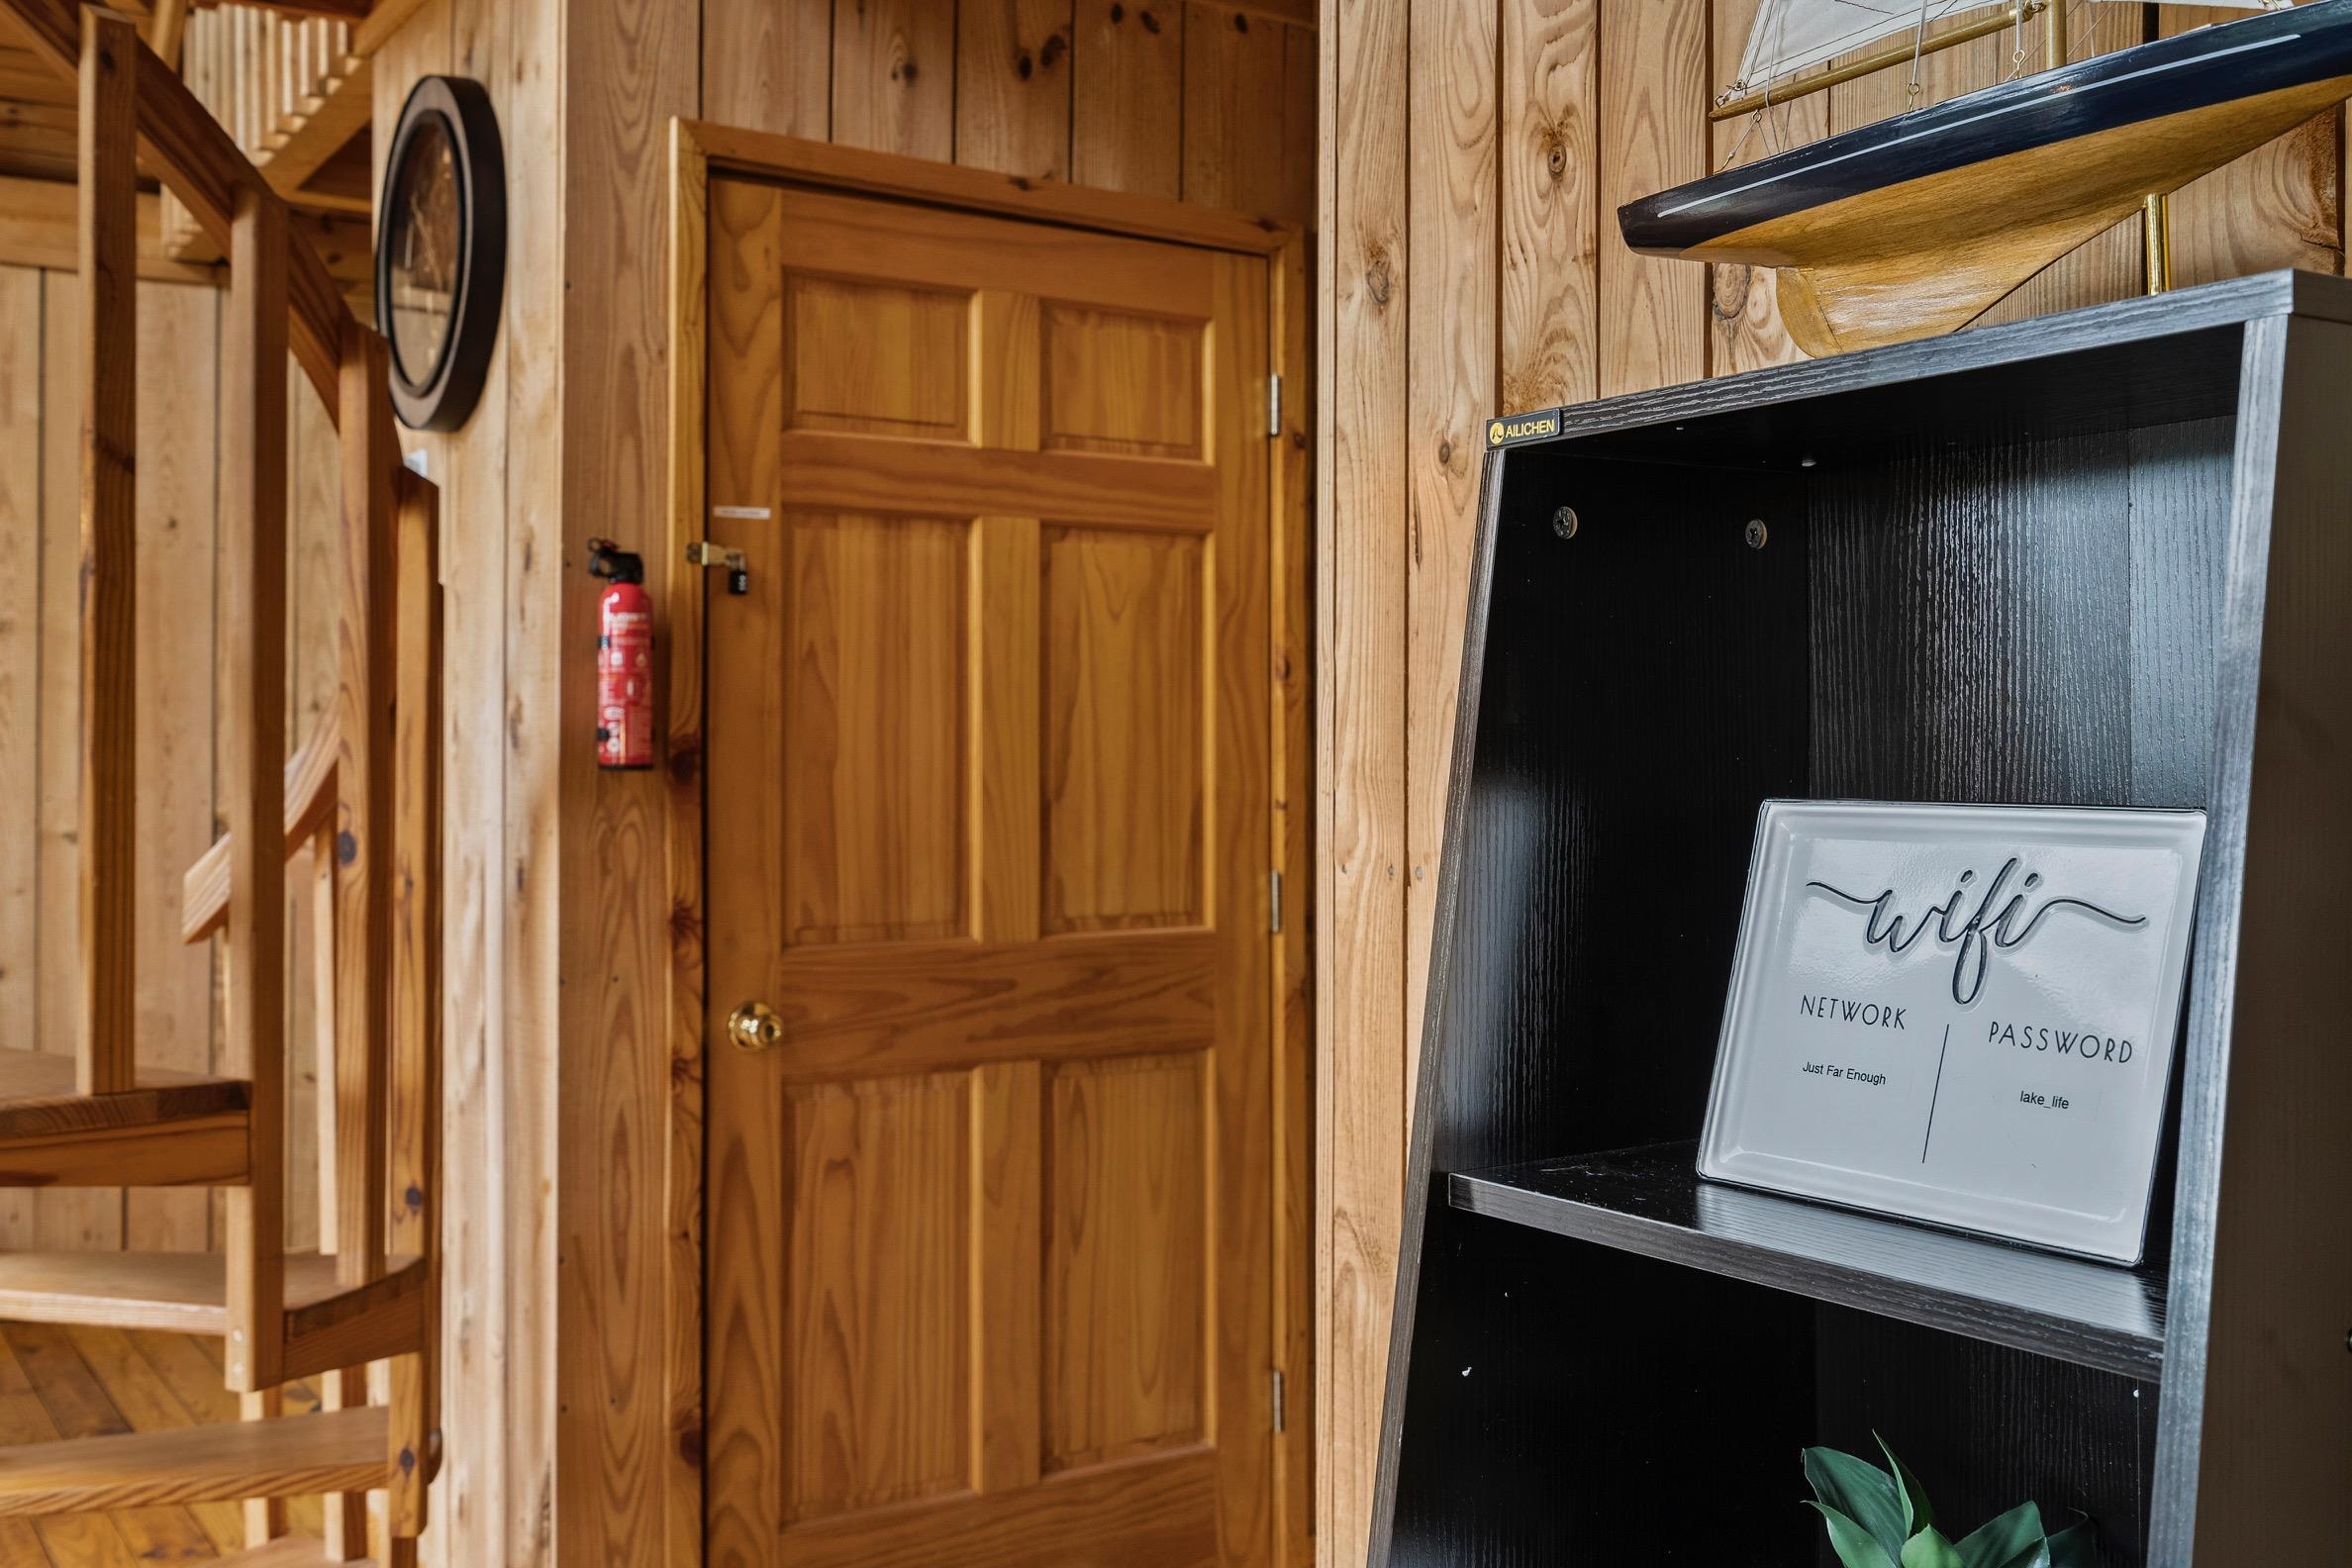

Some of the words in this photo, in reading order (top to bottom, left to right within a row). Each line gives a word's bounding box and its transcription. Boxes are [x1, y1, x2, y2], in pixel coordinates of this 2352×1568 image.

[1506, 419, 1555, 438] AILICHEN
[1806, 857, 2146, 1005] wifi
[1800, 995, 1908, 1030] NETWORK
[1988, 1021, 2133, 1064] PASSWORD
[1802, 1062, 1824, 1076] Just
[1826, 1065, 1845, 1078] Far
[1846, 1068, 1888, 1086] Enough
[2019, 1090, 2071, 1110] lake_life
